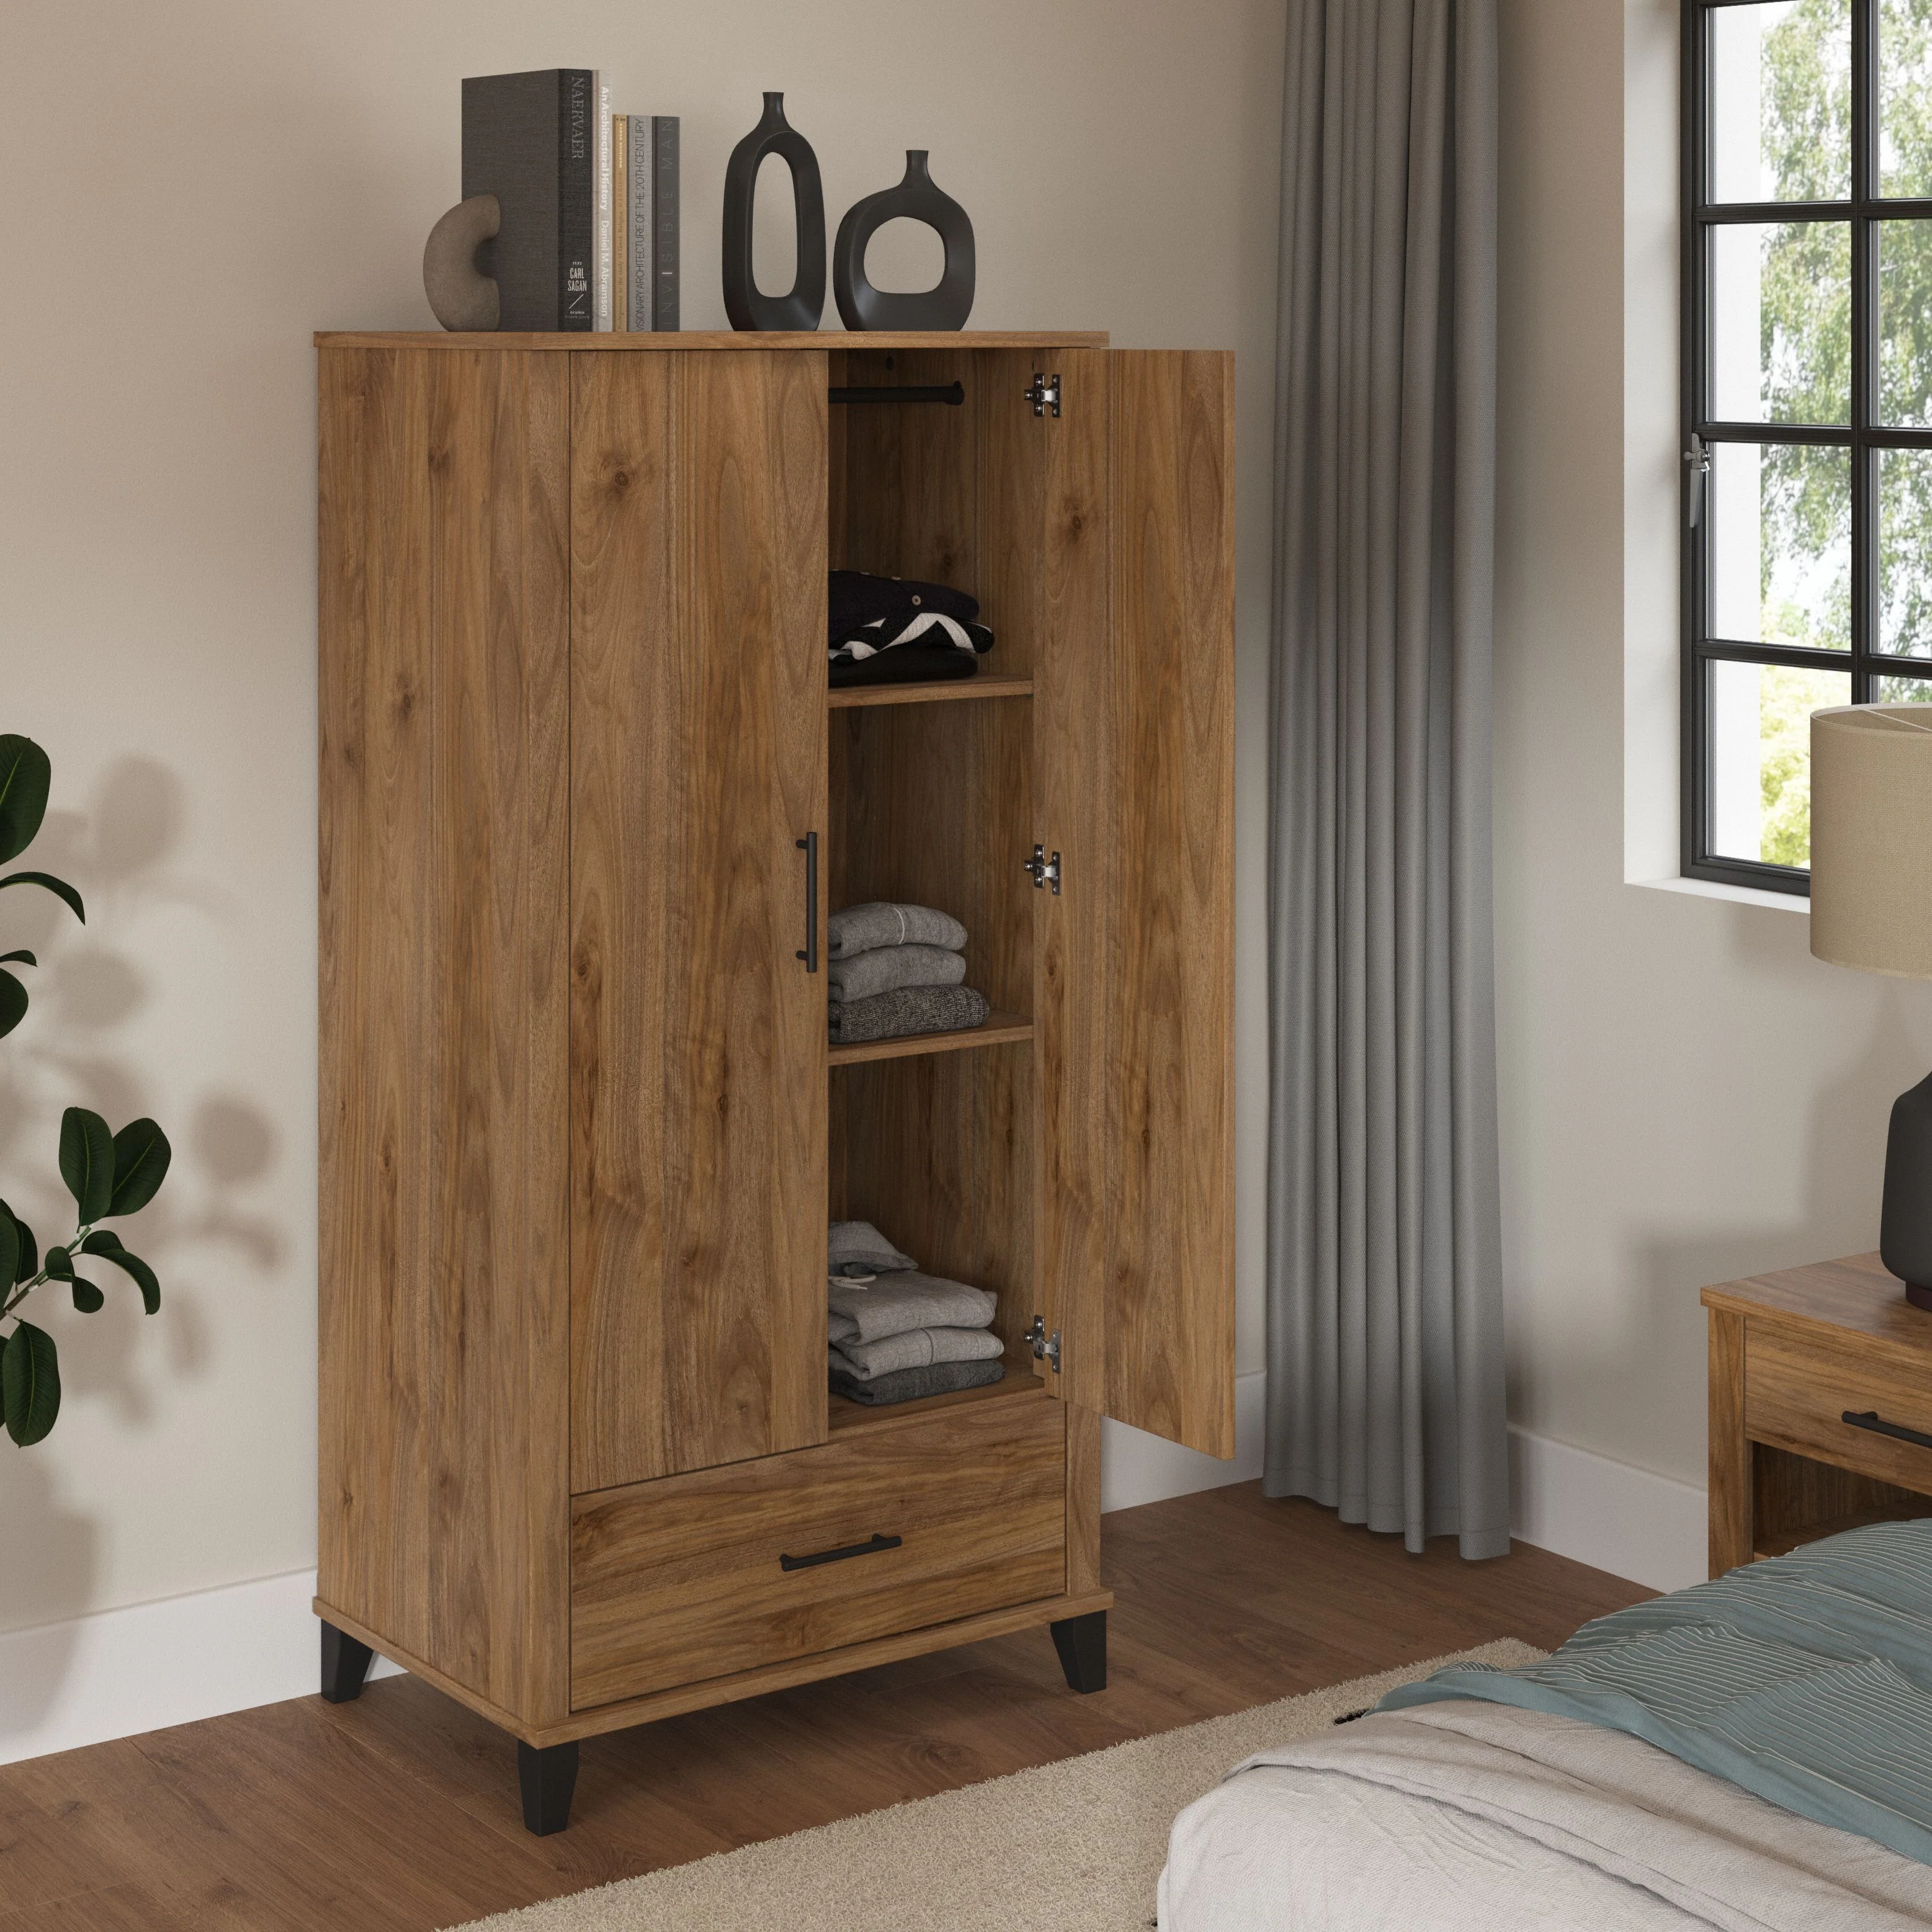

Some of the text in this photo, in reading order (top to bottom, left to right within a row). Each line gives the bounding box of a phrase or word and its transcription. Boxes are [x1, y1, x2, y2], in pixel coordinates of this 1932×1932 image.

[601, 86, 609, 100] An
[572, 77, 583, 159] NAERVAER
[600, 173, 609, 211] History
[636, 118, 645, 331] VISIONARY ARCHITECTURE OF THE 20TH CENTURY
[662, 120, 673, 325] INVISIBLE MAN
[601, 253, 609, 265] M.
[568, 280, 587, 292] SAGAN
[570, 268, 584, 279] CARL
